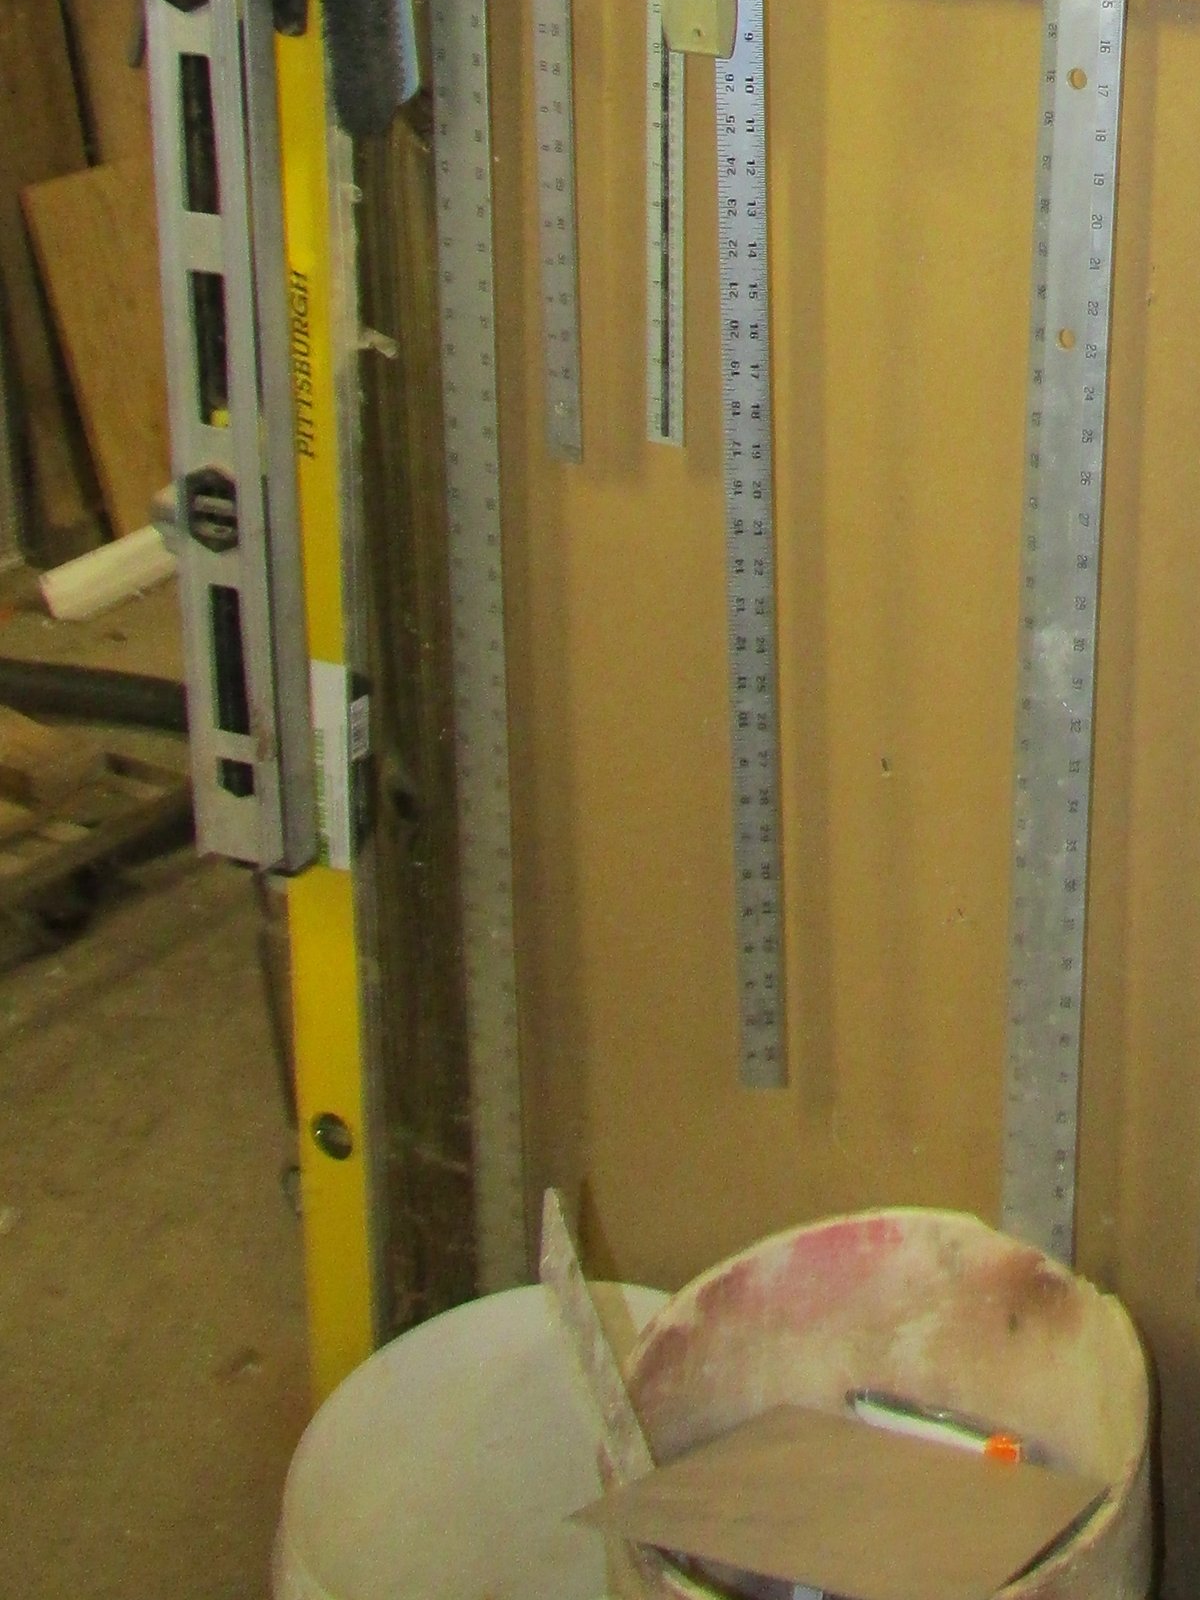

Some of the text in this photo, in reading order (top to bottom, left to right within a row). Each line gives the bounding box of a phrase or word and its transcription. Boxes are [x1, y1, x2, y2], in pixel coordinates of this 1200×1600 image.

[744, 33, 754, 41] 9
[745, 75, 755, 94] 10
[746, 119, 755, 133] 11
[746, 159, 756, 176] 12
[725, 74, 739, 299] 26 25 24 23 22 21
[291, 270, 315, 460] PITTSBURGH
